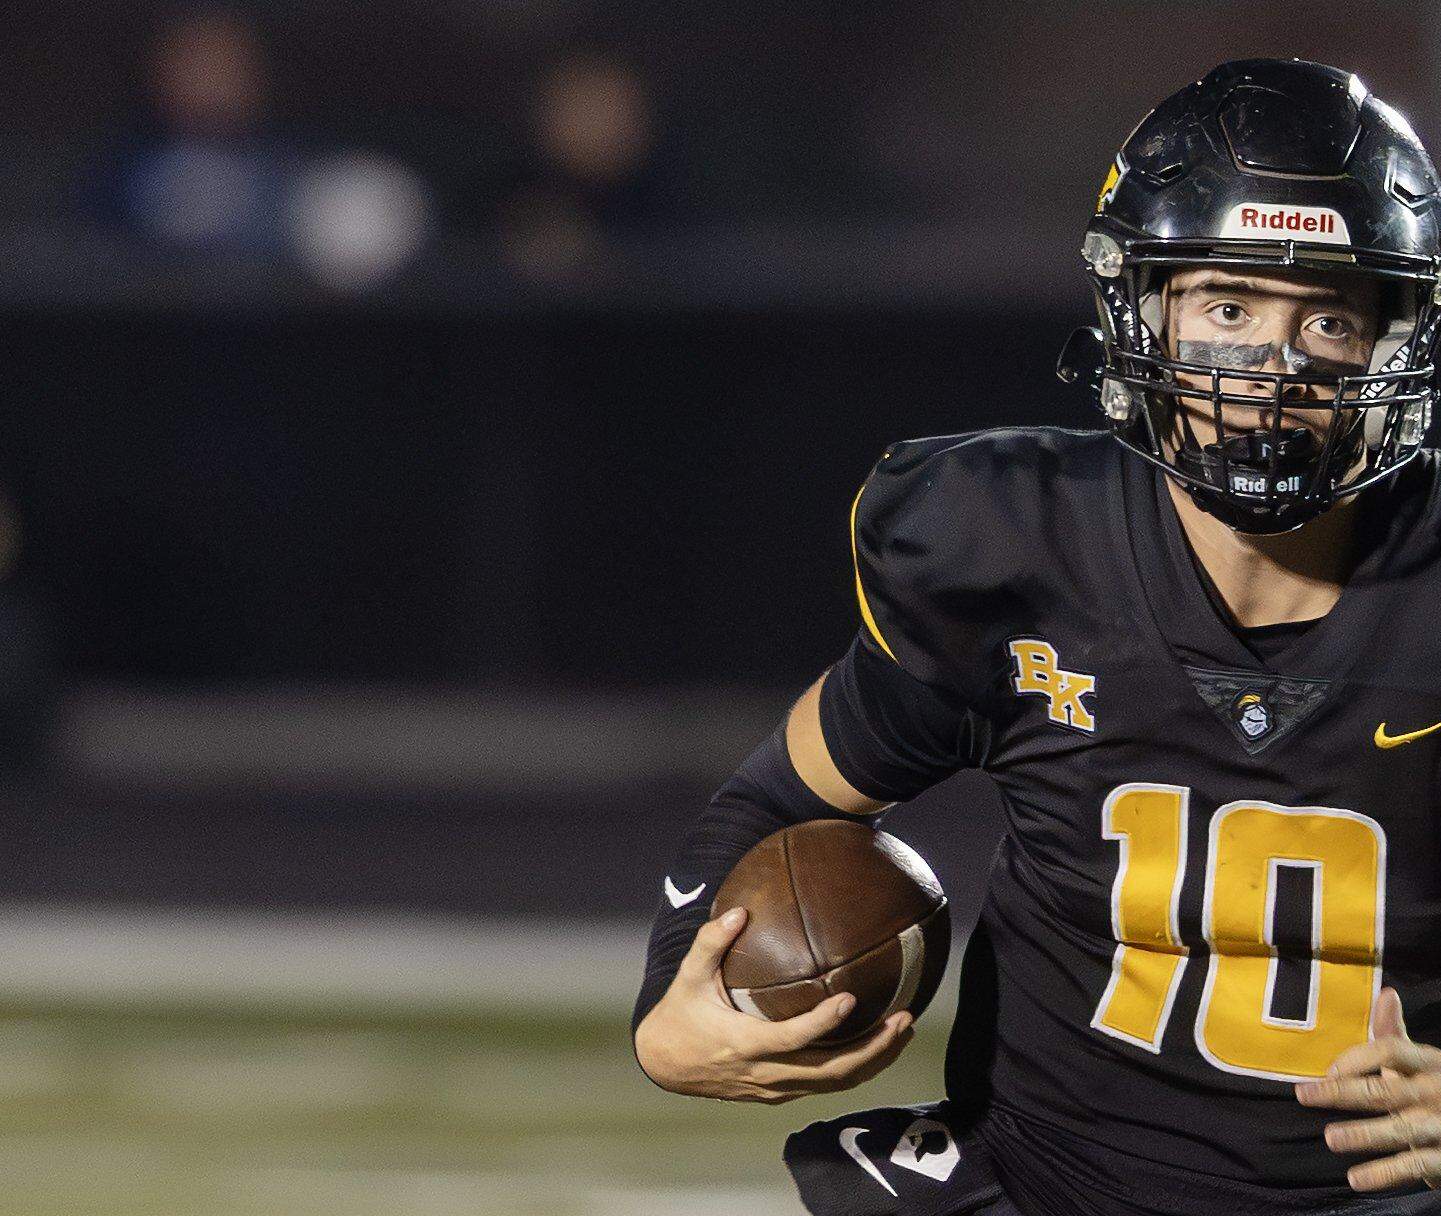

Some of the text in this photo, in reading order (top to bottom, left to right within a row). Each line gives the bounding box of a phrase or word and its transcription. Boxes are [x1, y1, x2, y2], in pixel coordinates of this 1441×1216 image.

[1241, 208, 1335, 234] Riddell
[1233, 476, 1300, 493] Ridell
[1009, 639, 1096, 732] BK
[1090, 782, 1387, 1083] 10
